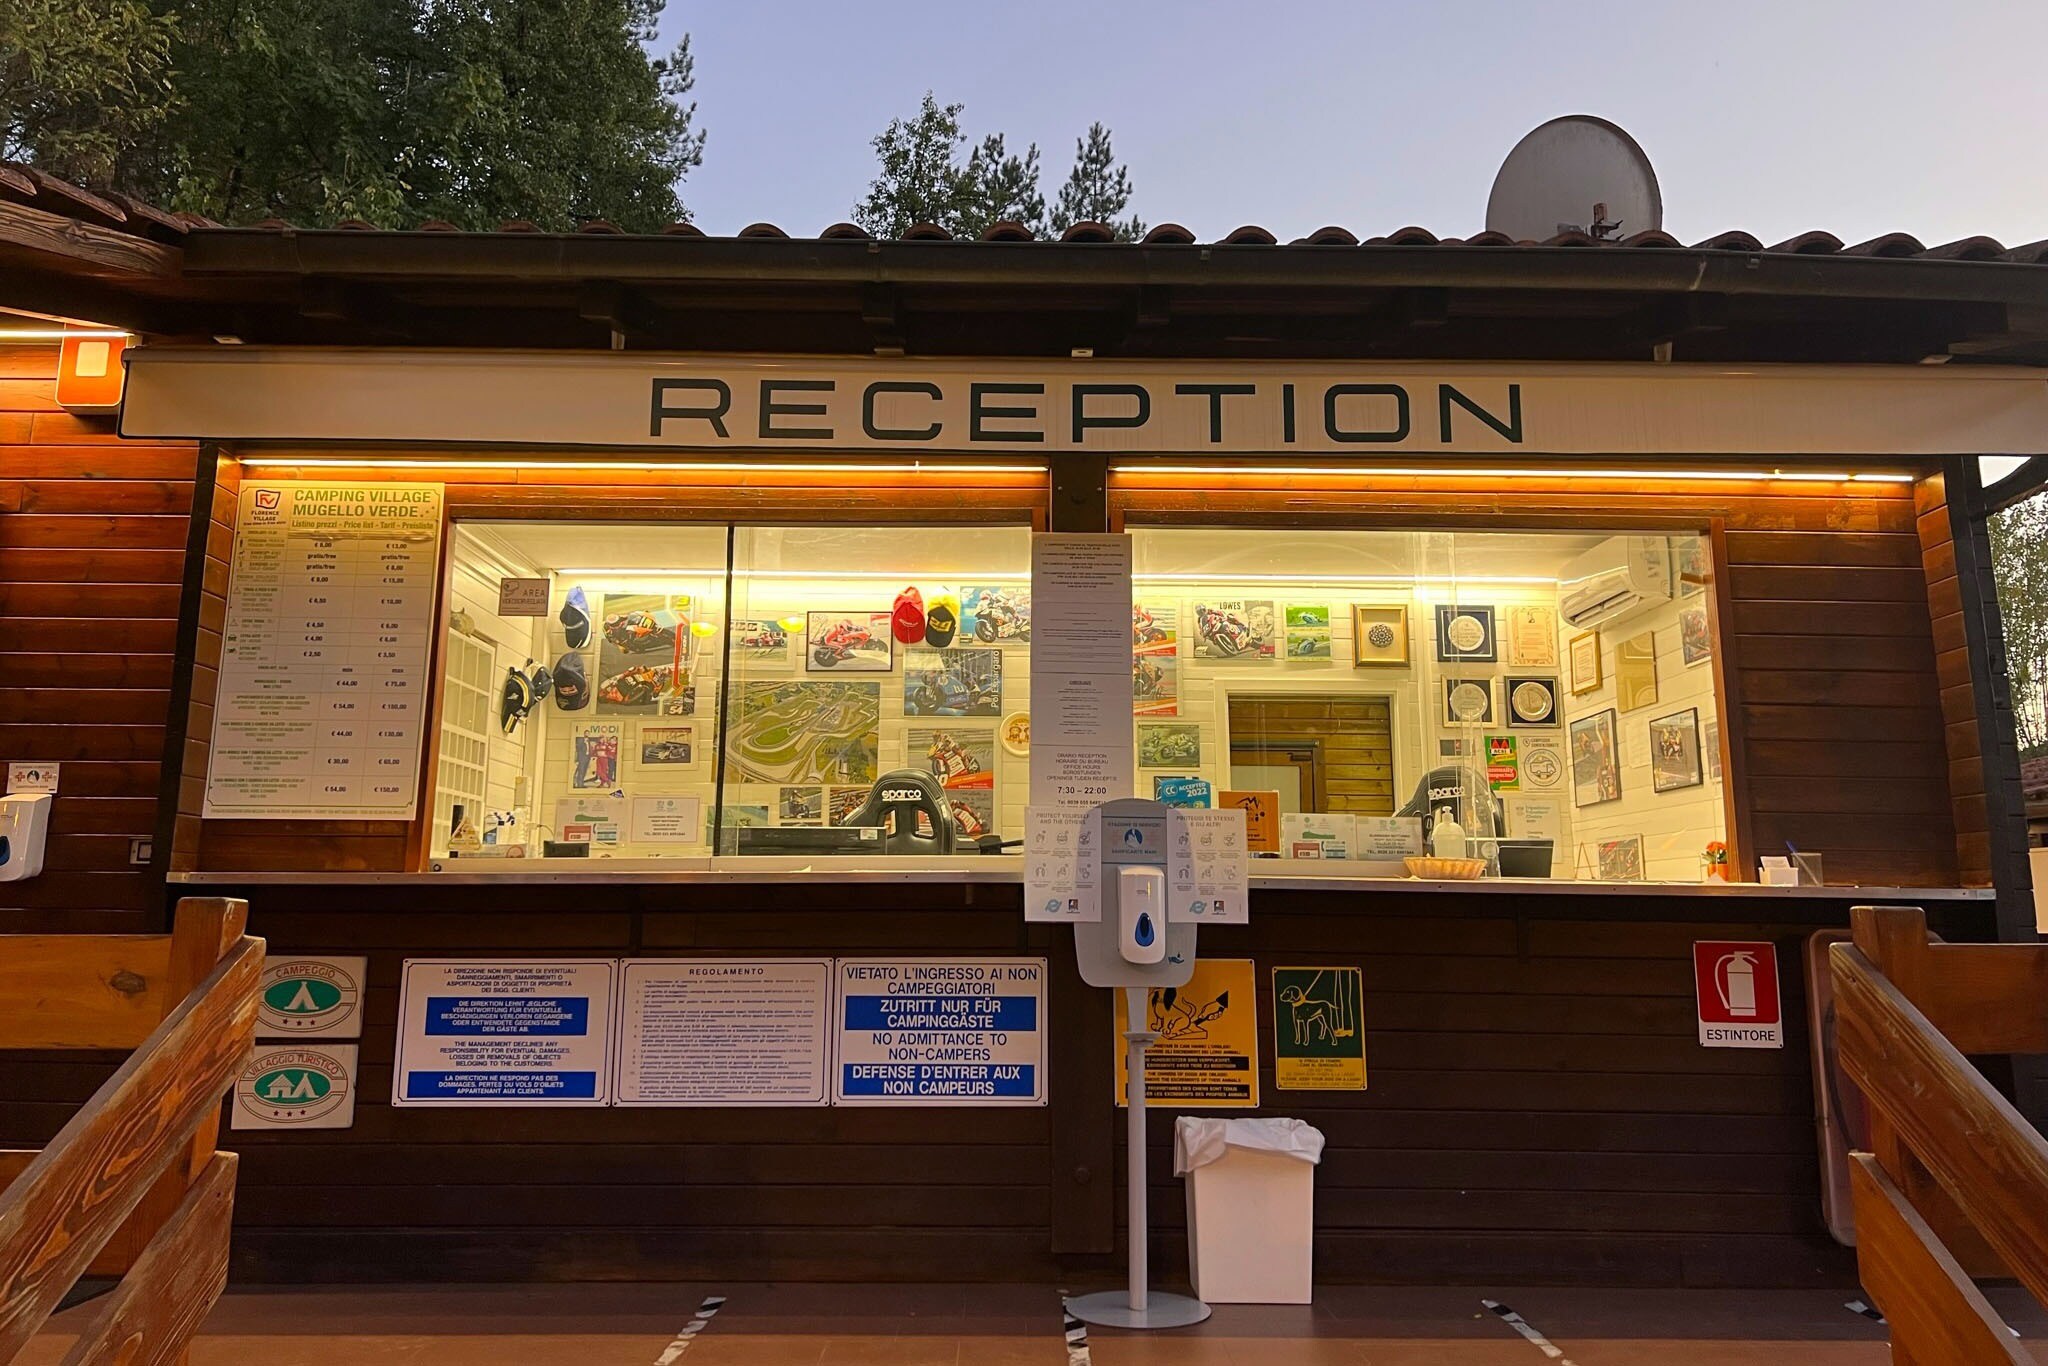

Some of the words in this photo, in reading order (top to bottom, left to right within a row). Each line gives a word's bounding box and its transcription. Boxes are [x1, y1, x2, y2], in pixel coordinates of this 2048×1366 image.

[649, 378, 1522, 443] RECEPTION
[295, 490, 365, 502] CAMPING
[370, 491, 431, 503] VILLAGE
[293, 504, 364, 516] MUGELLO
[369, 505, 418, 517] VERDE
[292, 520, 315, 528] Listino
[316, 520, 337, 530] prezzi
[344, 521, 361, 529] Price
[363, 521, 373, 529] list
[402, 521, 434, 530] Preisliste
[522, 589, 545, 597] AREA
[1220, 601, 1241, 610] LOWES
[1057, 786, 1075, 794] 7:30
[1179, 782, 1206, 791] ACCEPTED
[1187, 788, 1208, 797] 2022
[276, 965, 336, 979] CAMPEGGIO
[846, 968, 898, 980] VIETATO
[904, 968, 985, 980] L'INGRESSO
[990, 968, 1003, 980] AI
[1008, 968, 1037, 980] NON
[887, 982, 995, 995] CAMPEGGIATORI
[880, 1000, 936, 1013] ZUTRITT
[941, 1000, 969, 1013] NUR
[974, 997, 1001, 1013] FÜR
[887, 1011, 994, 1028] CAMPINGGÄSTE
[872, 1033, 892, 1045] NO
[898, 1033, 984, 1045] ADMITTANCE
[990, 1033, 1007, 1046] TO
[1706, 1029, 1775, 1041] ESTINTORE
[889, 1048, 991, 1061] NON-CAMPERS
[248, 1054, 295, 1076] VILLAGGIO
[297, 1054, 340, 1075] TURISTICO
[852, 1066, 916, 1079] DEFENSE
[921, 1066, 988, 1079] D'ENTRER
[993, 1066, 1020, 1080] AUX
[883, 1081, 914, 1094] NON
[919, 1081, 995, 1095] CAMPEURS
